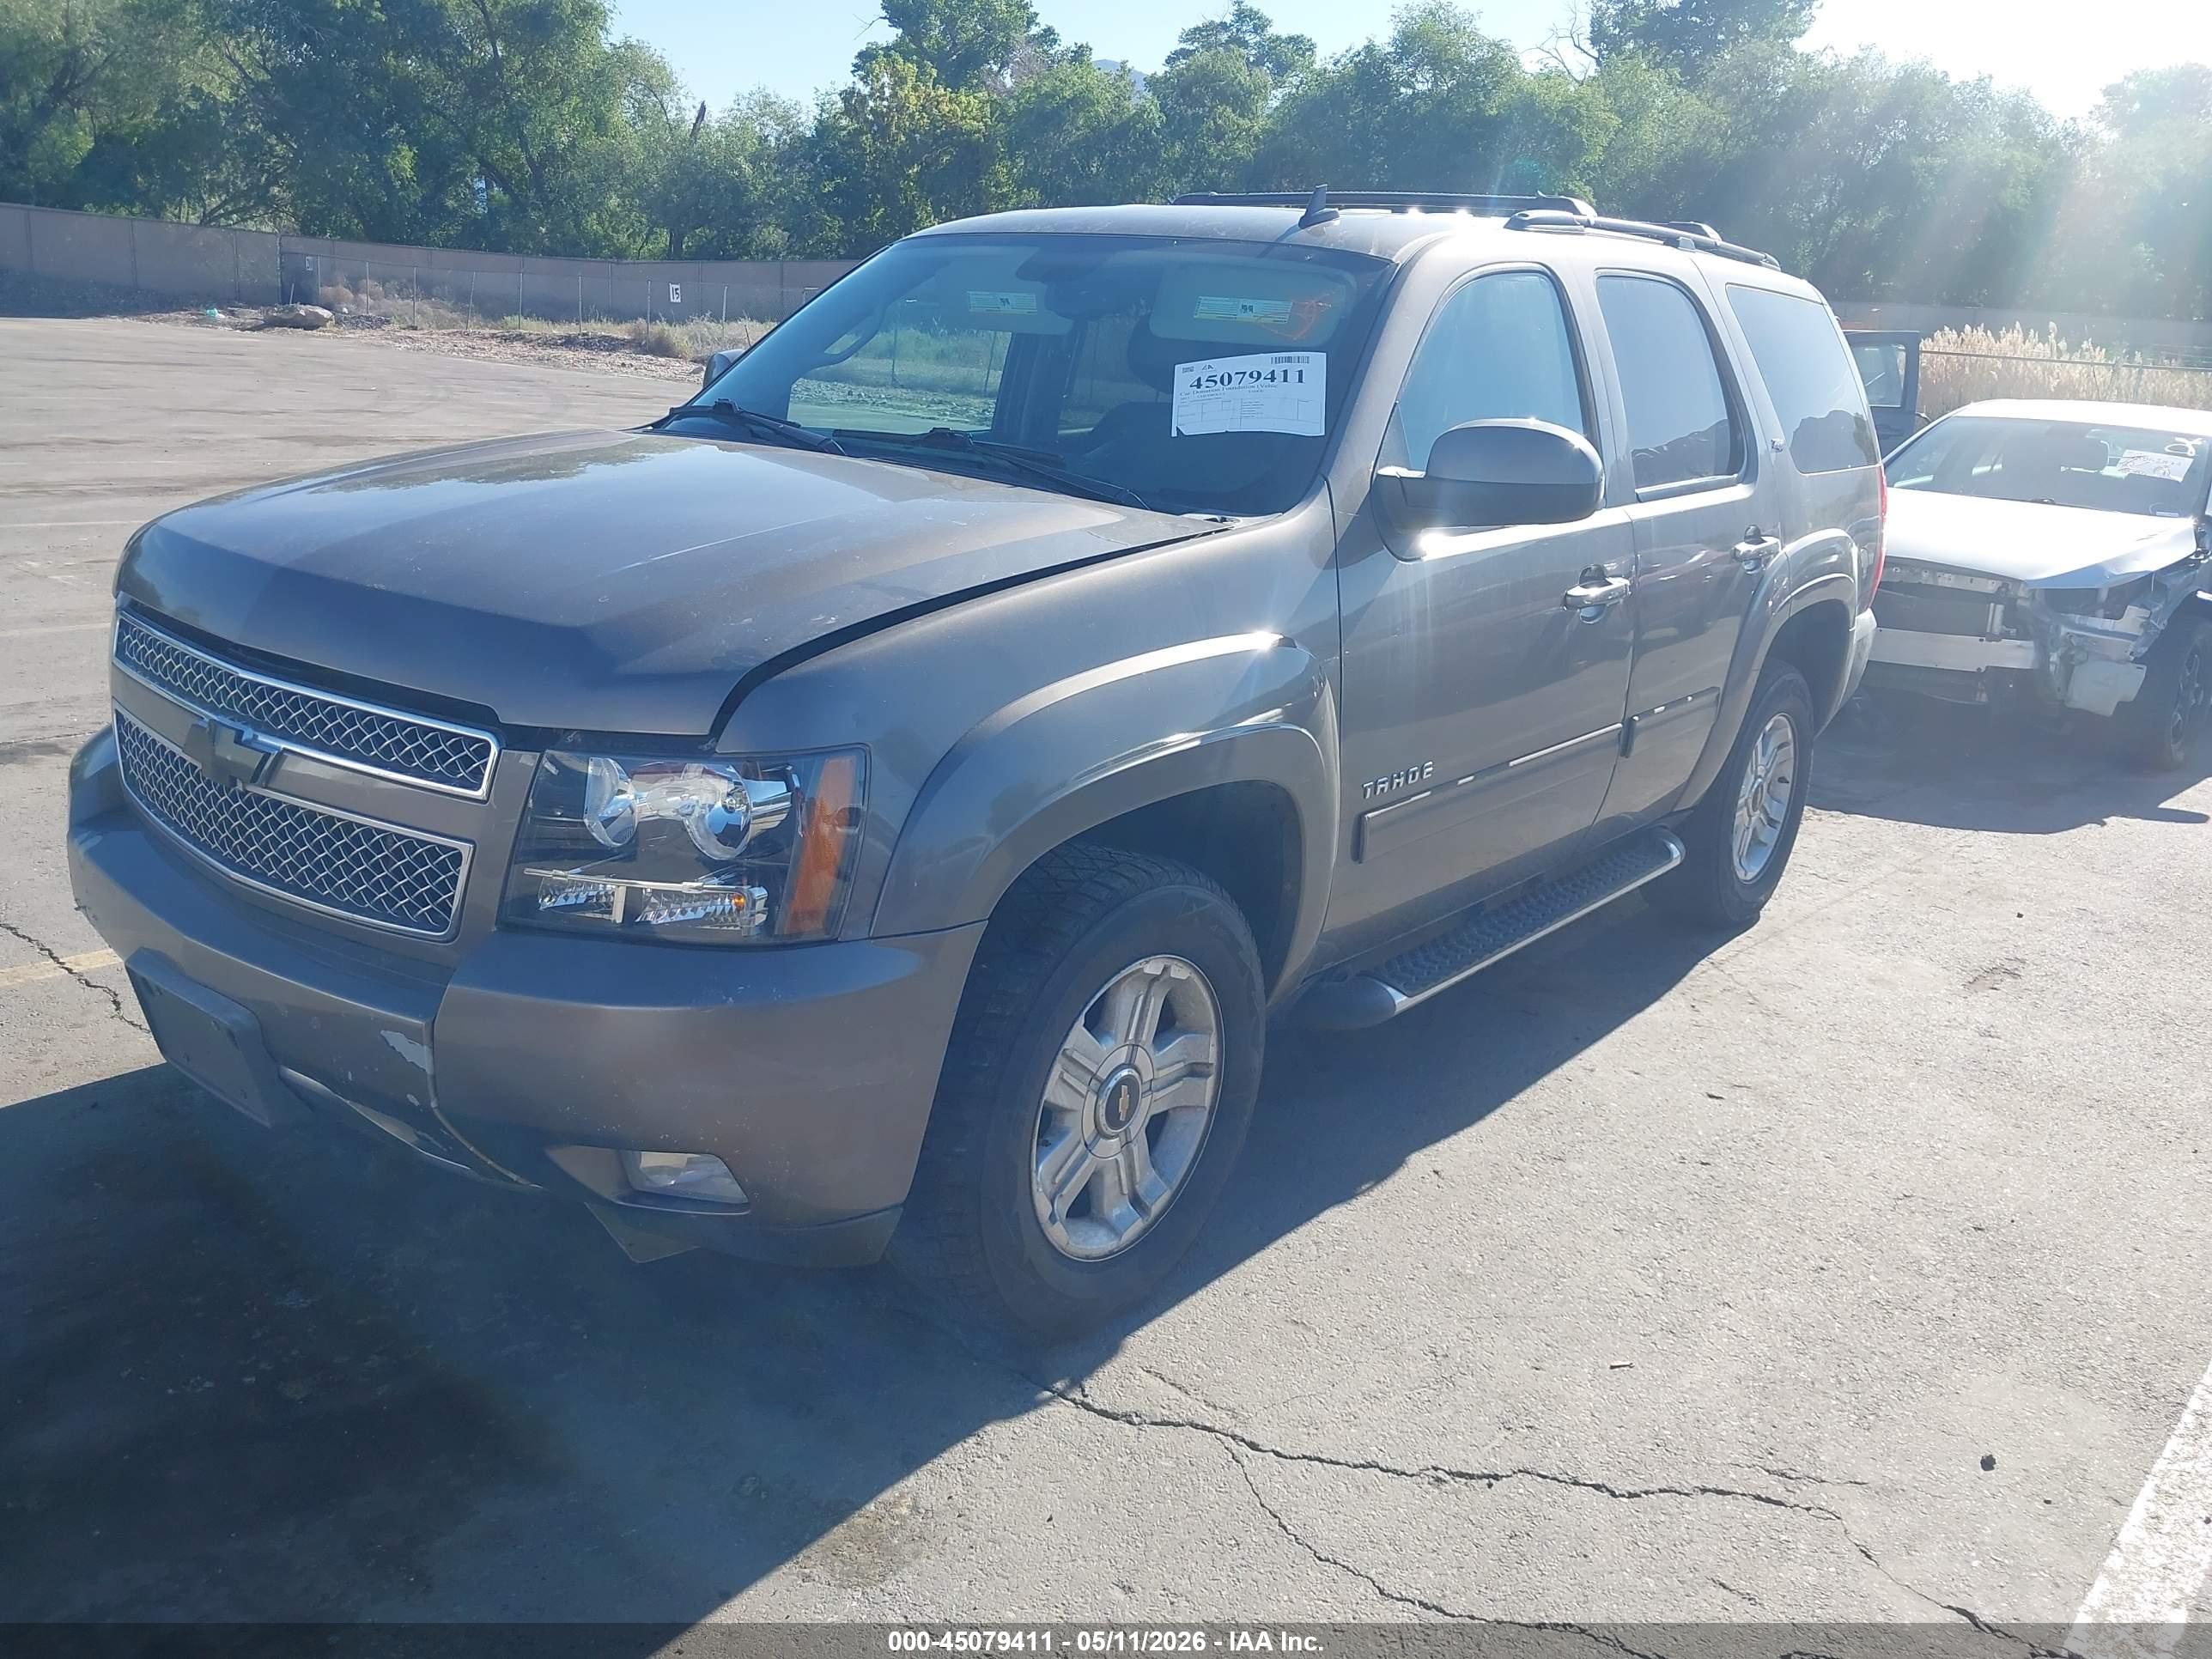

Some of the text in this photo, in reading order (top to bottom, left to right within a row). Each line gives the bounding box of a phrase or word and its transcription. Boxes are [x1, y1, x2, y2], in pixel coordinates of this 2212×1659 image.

[672, 287, 680, 301] 15
[1189, 369, 1306, 390] 45079411
[1362, 761, 1433, 799] TAHOE
